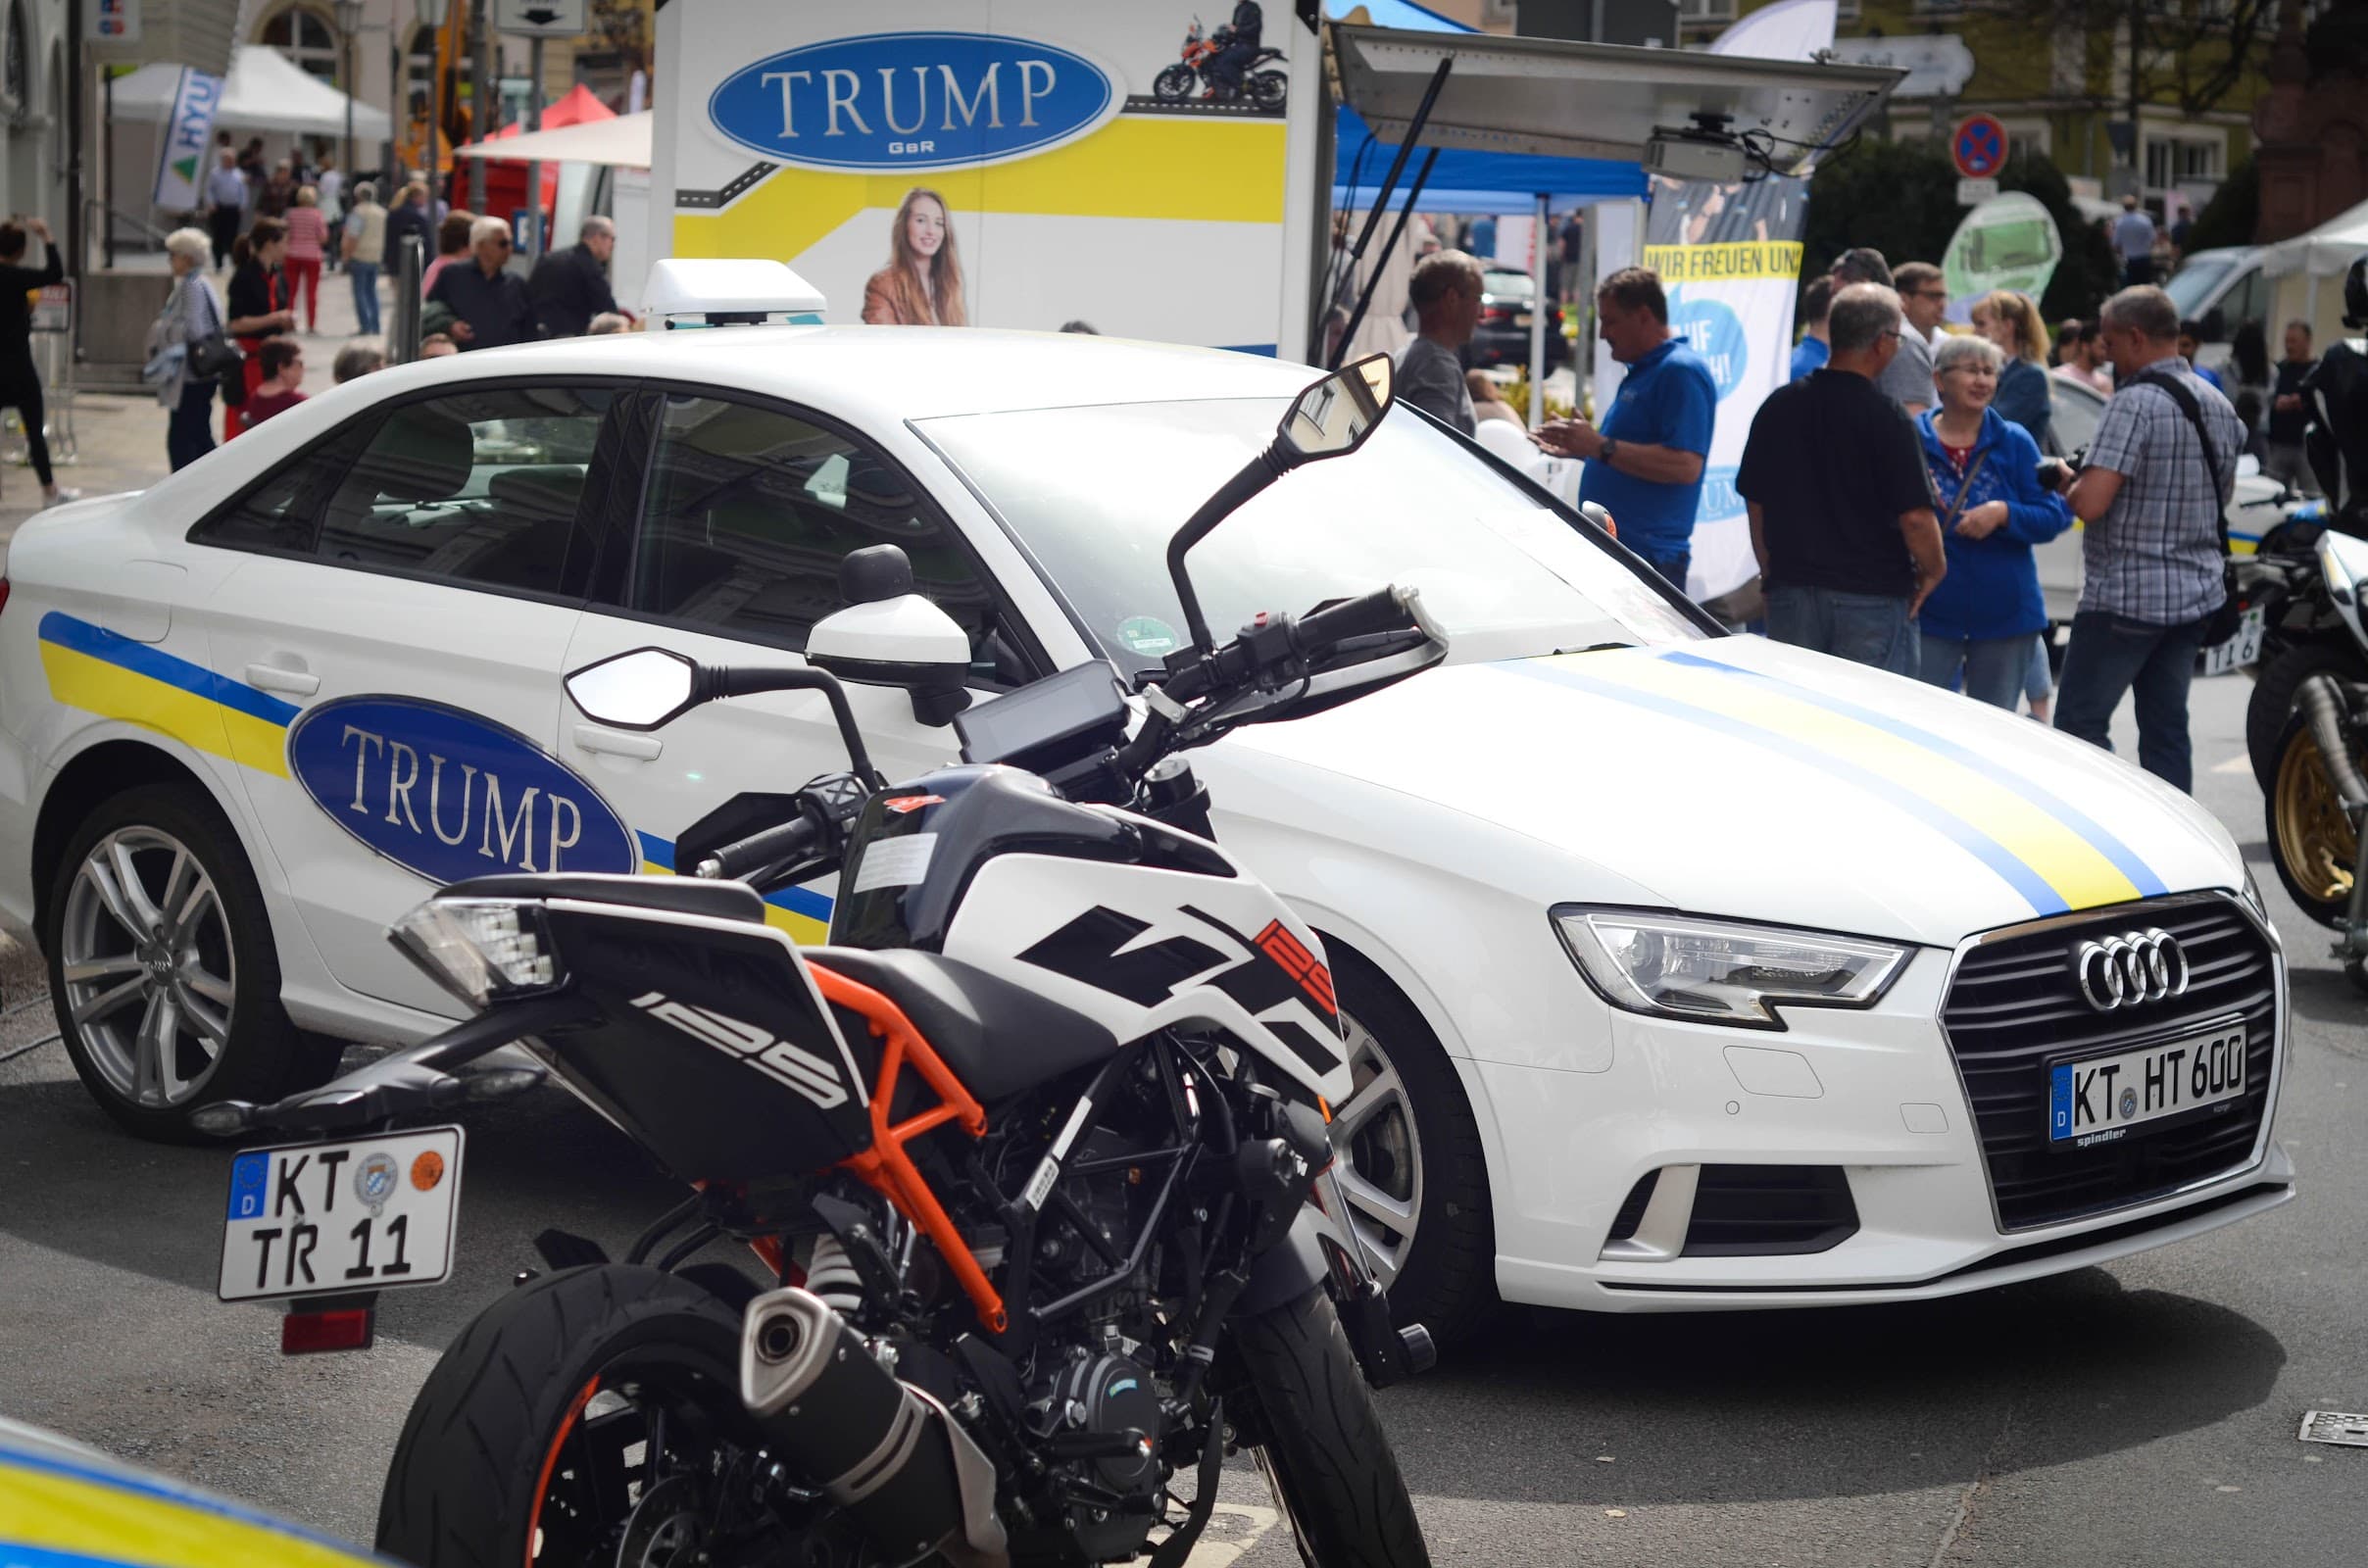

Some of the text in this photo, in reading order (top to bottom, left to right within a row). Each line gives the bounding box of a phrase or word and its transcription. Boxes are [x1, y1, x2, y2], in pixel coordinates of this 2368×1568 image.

[177, 70, 213, 149] HYU
[761, 60, 1056, 138] TRUMP
[1648, 250, 1685, 277] WIR
[1690, 247, 1763, 275] FREUEN
[341, 724, 582, 874] TRUMP
[2057, 1034, 2243, 1127] D KT HT 600
[2077, 1128, 2127, 1148] spindler
[241, 1150, 350, 1218] D KT
[252, 1214, 412, 1290] TR 11
